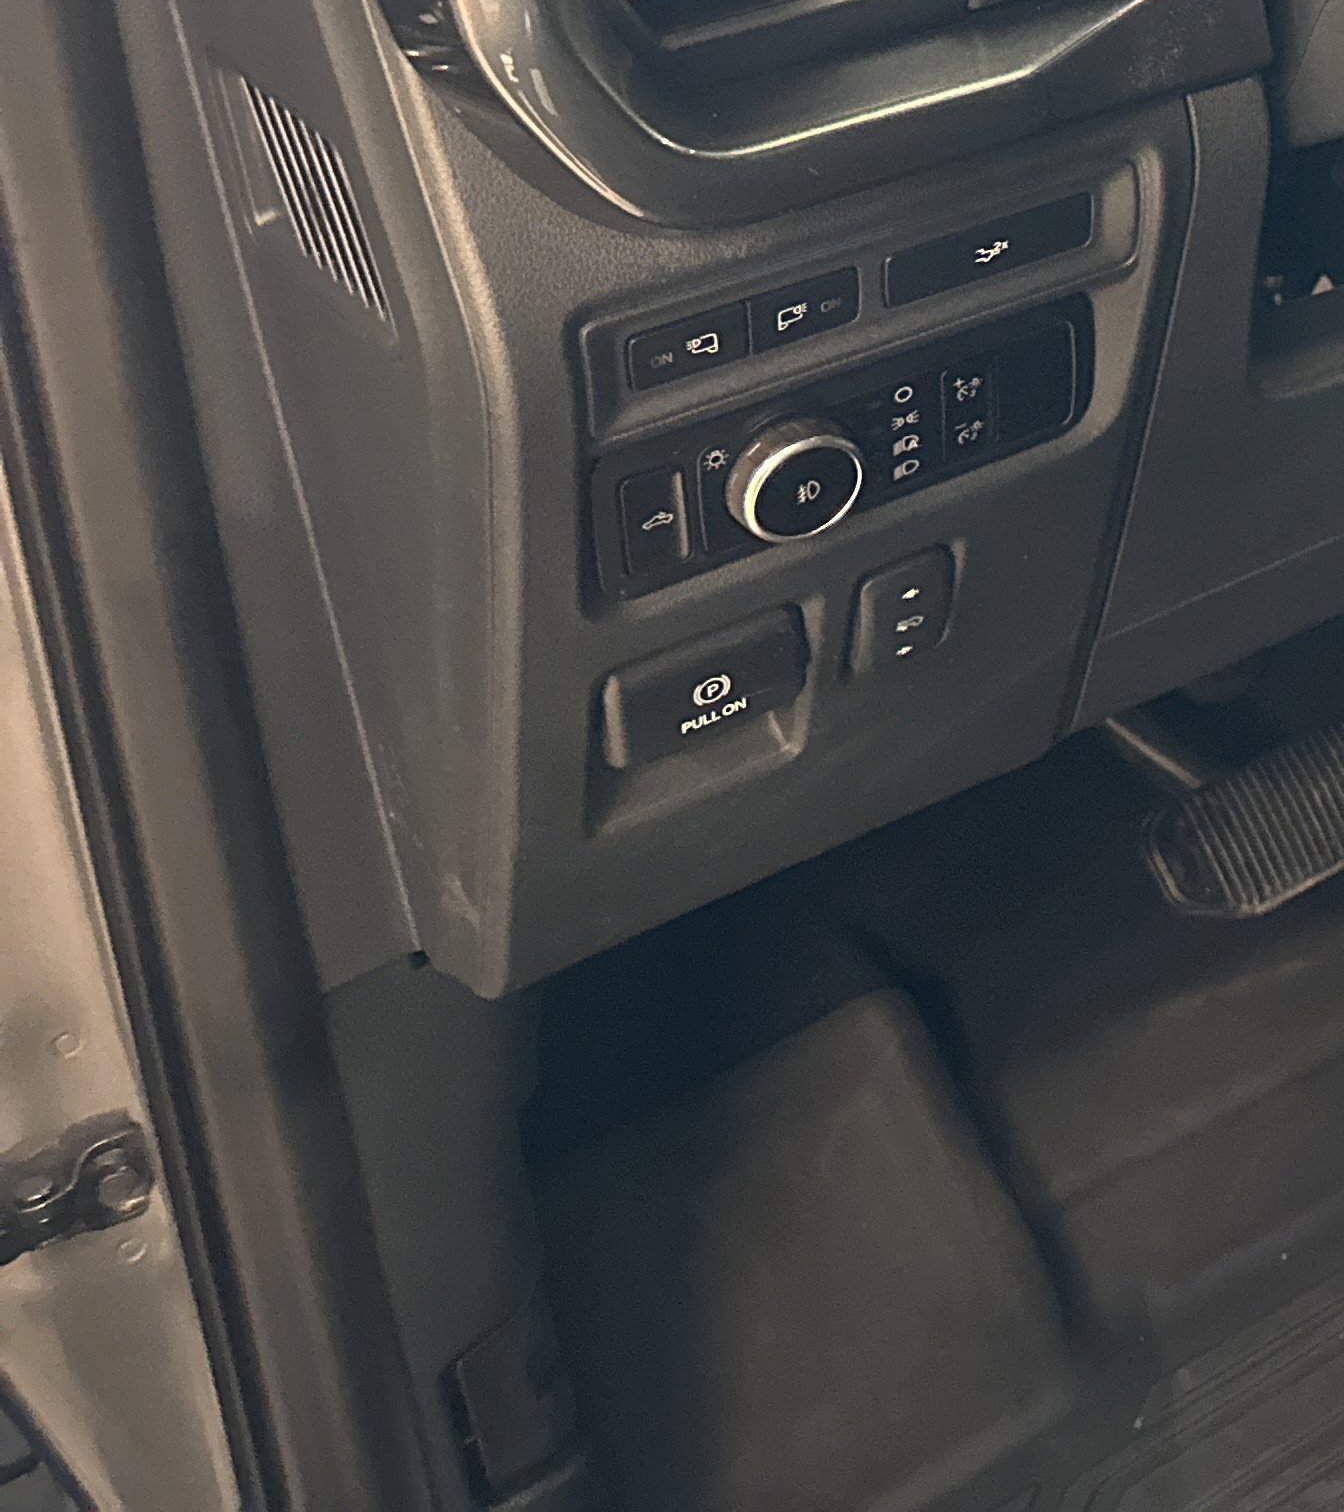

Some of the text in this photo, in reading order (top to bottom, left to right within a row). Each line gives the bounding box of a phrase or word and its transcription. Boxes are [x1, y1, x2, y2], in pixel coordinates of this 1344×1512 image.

[819, 297, 842, 314] ON
[650, 351, 673, 369] ON
[681, 696, 747, 734] PULL ON
